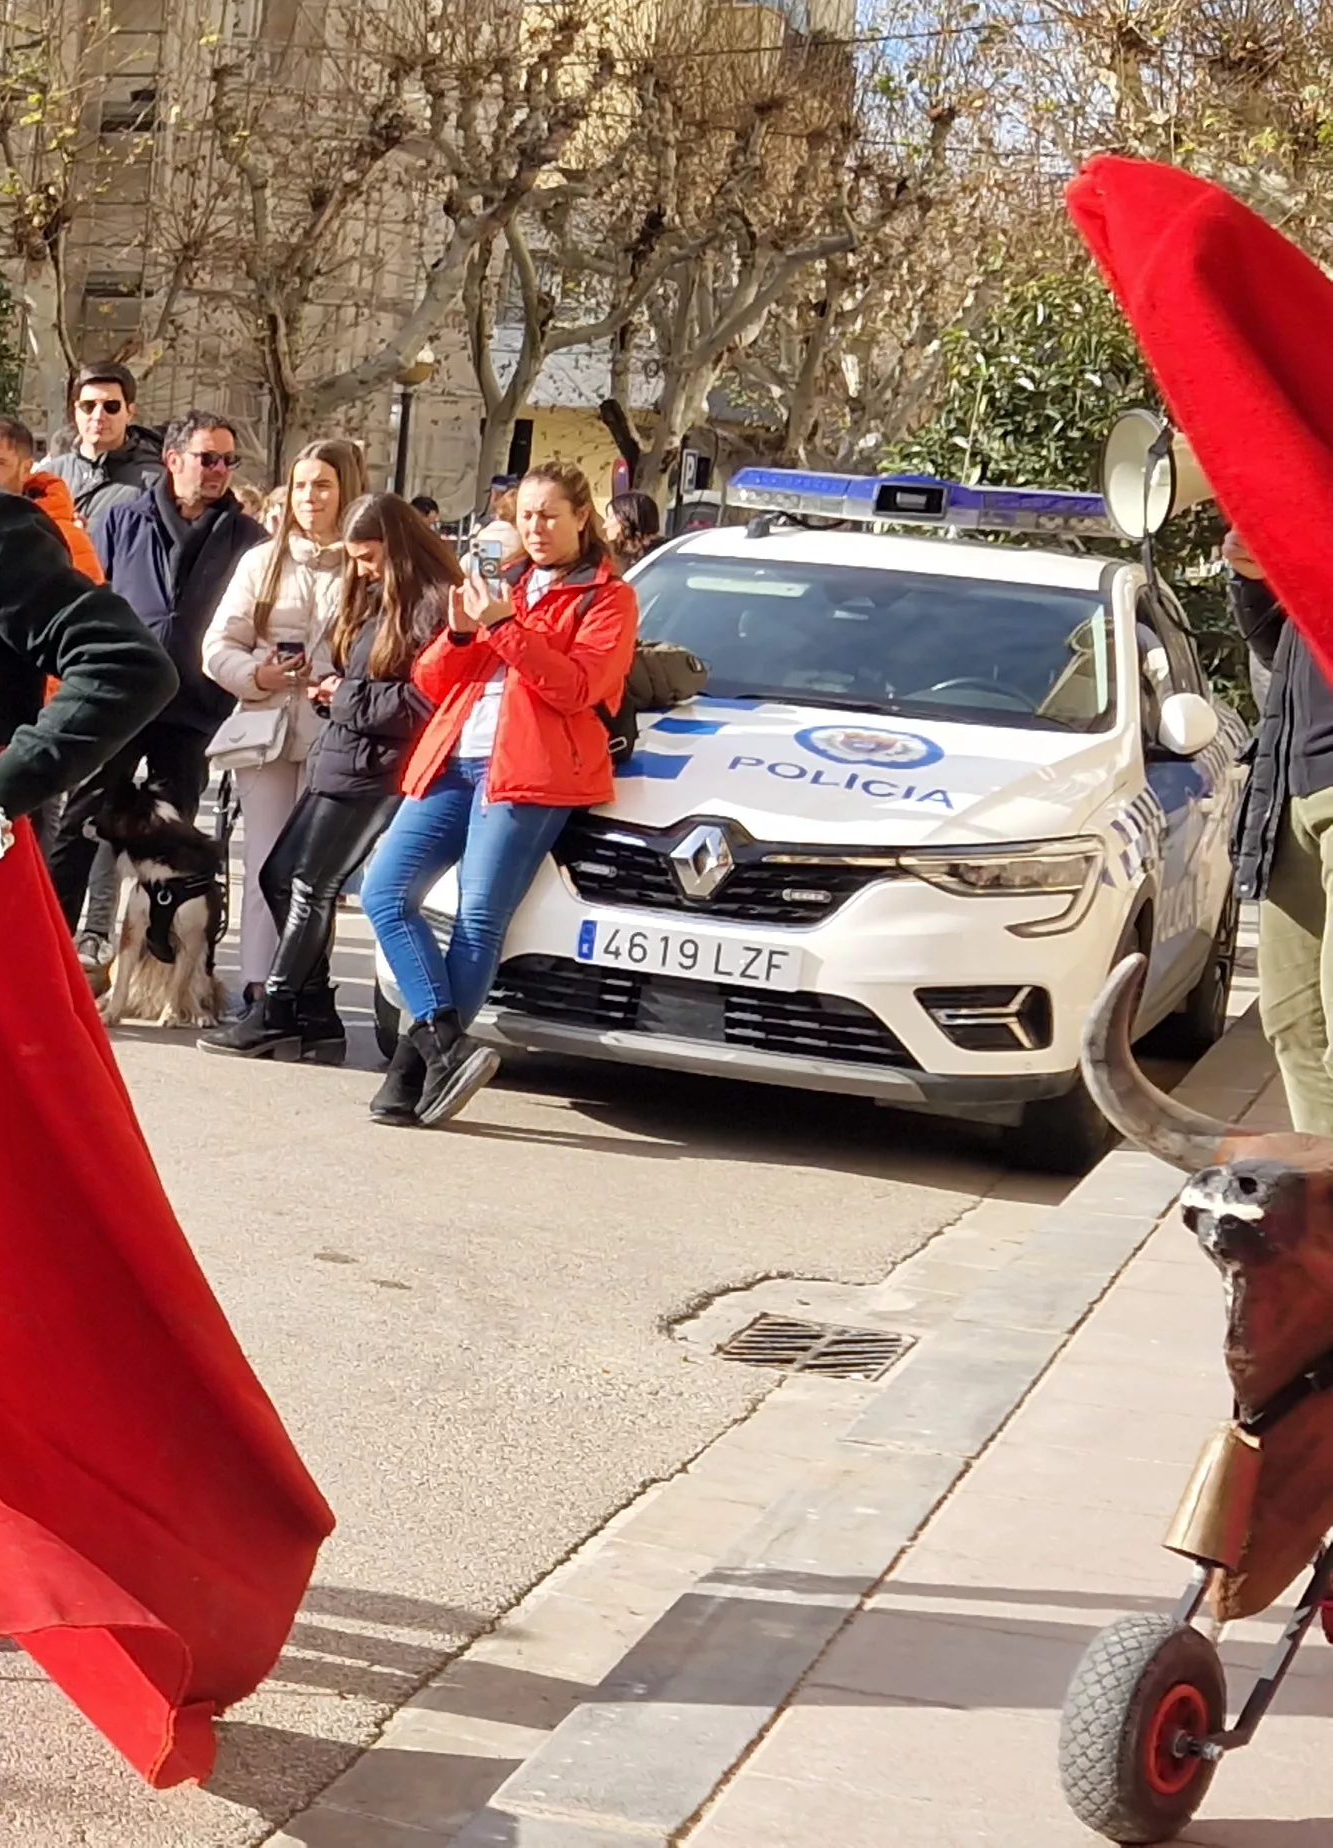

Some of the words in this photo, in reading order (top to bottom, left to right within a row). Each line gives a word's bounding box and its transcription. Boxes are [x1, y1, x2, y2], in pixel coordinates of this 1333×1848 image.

[684, 454, 695, 490] P
[727, 755, 955, 810] POLICIA
[602, 928, 700, 971] 4619
[712, 941, 790, 982] LZF
